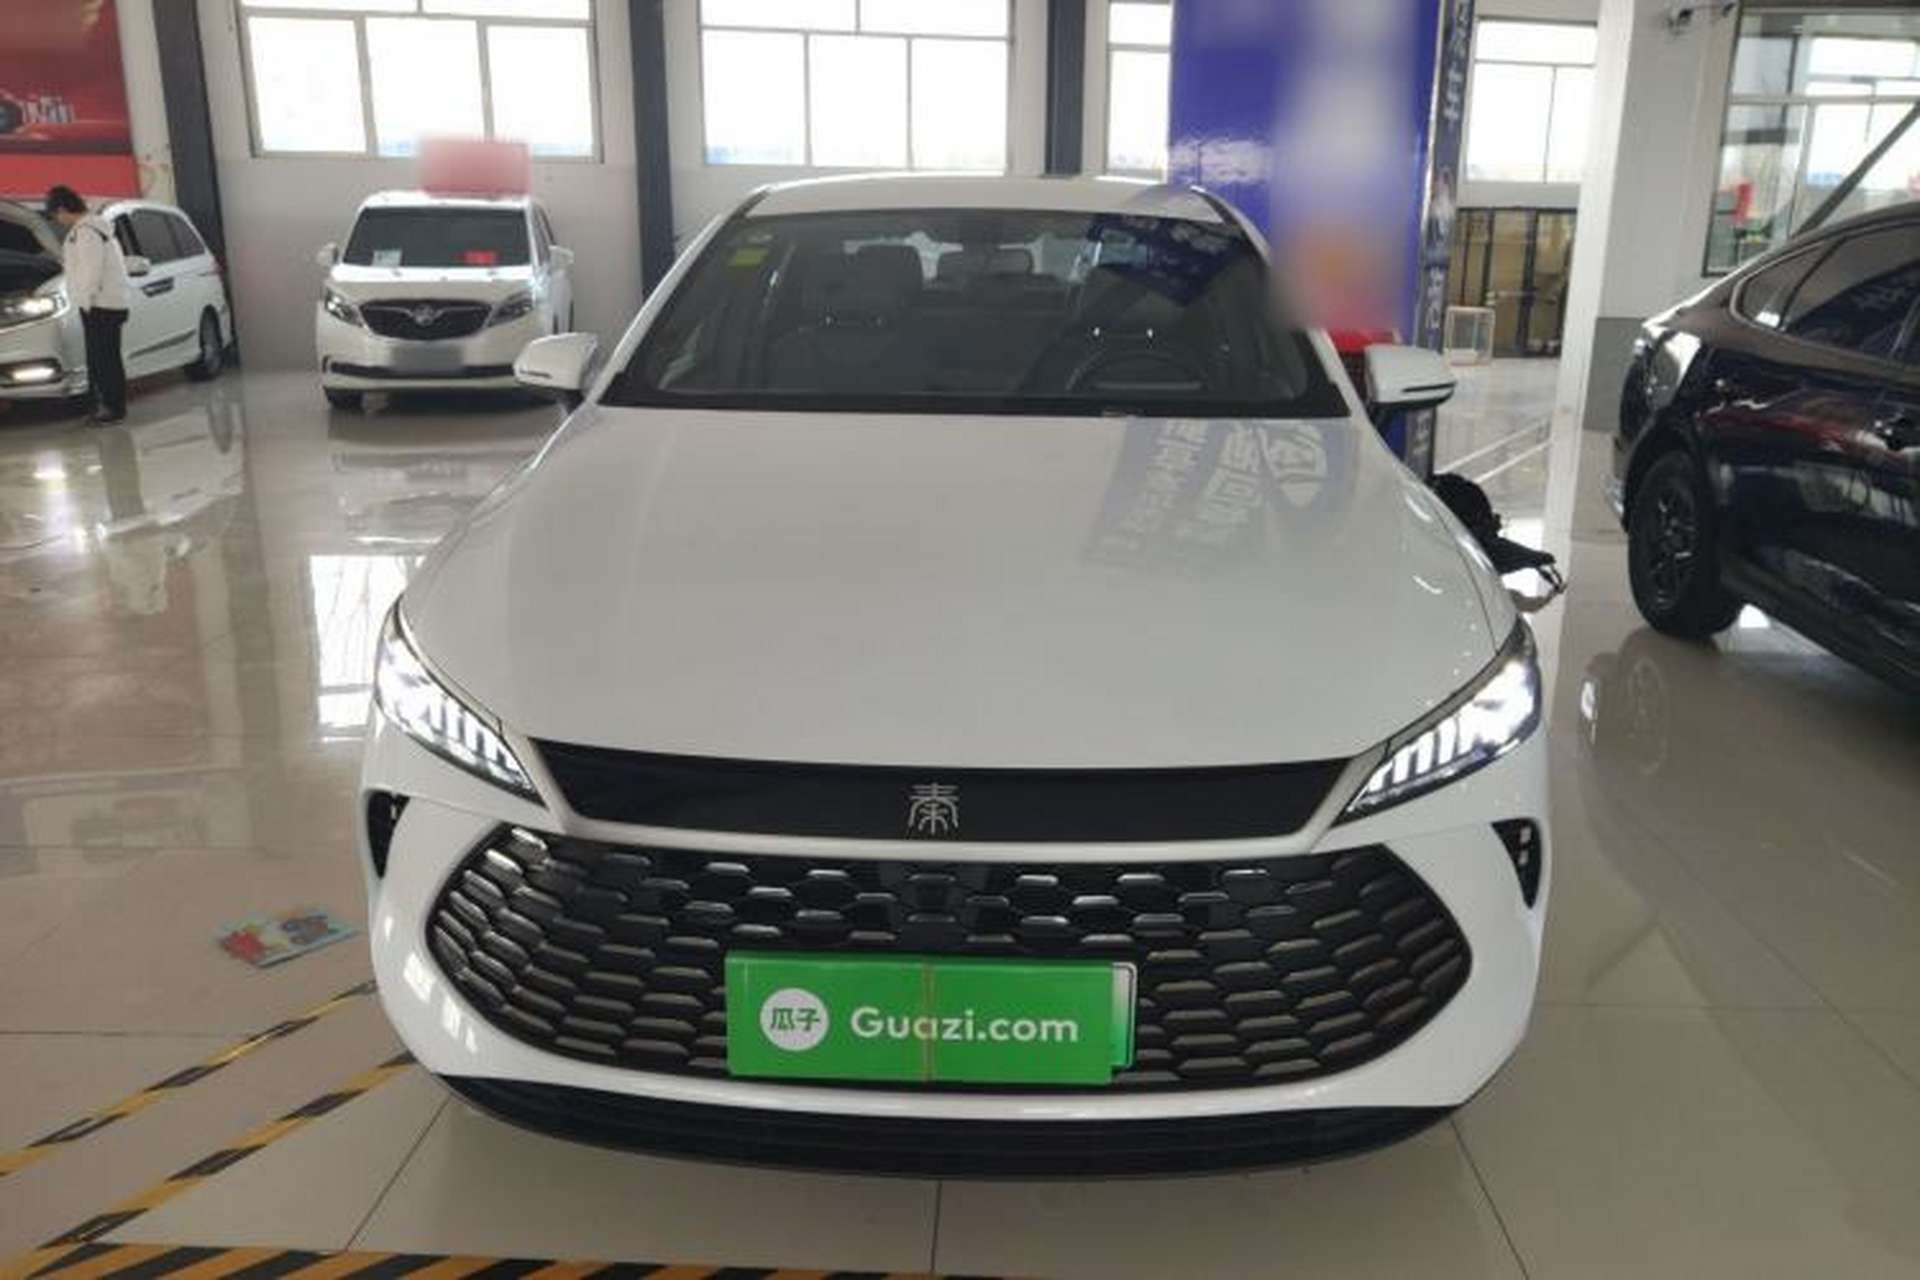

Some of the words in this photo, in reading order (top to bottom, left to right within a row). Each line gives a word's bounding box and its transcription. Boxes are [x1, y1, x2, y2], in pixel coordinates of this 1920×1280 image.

[907, 782, 961, 836] 秦
[769, 1006, 821, 1032] 瓜子
[850, 1007, 1079, 1044] Guazi.com
